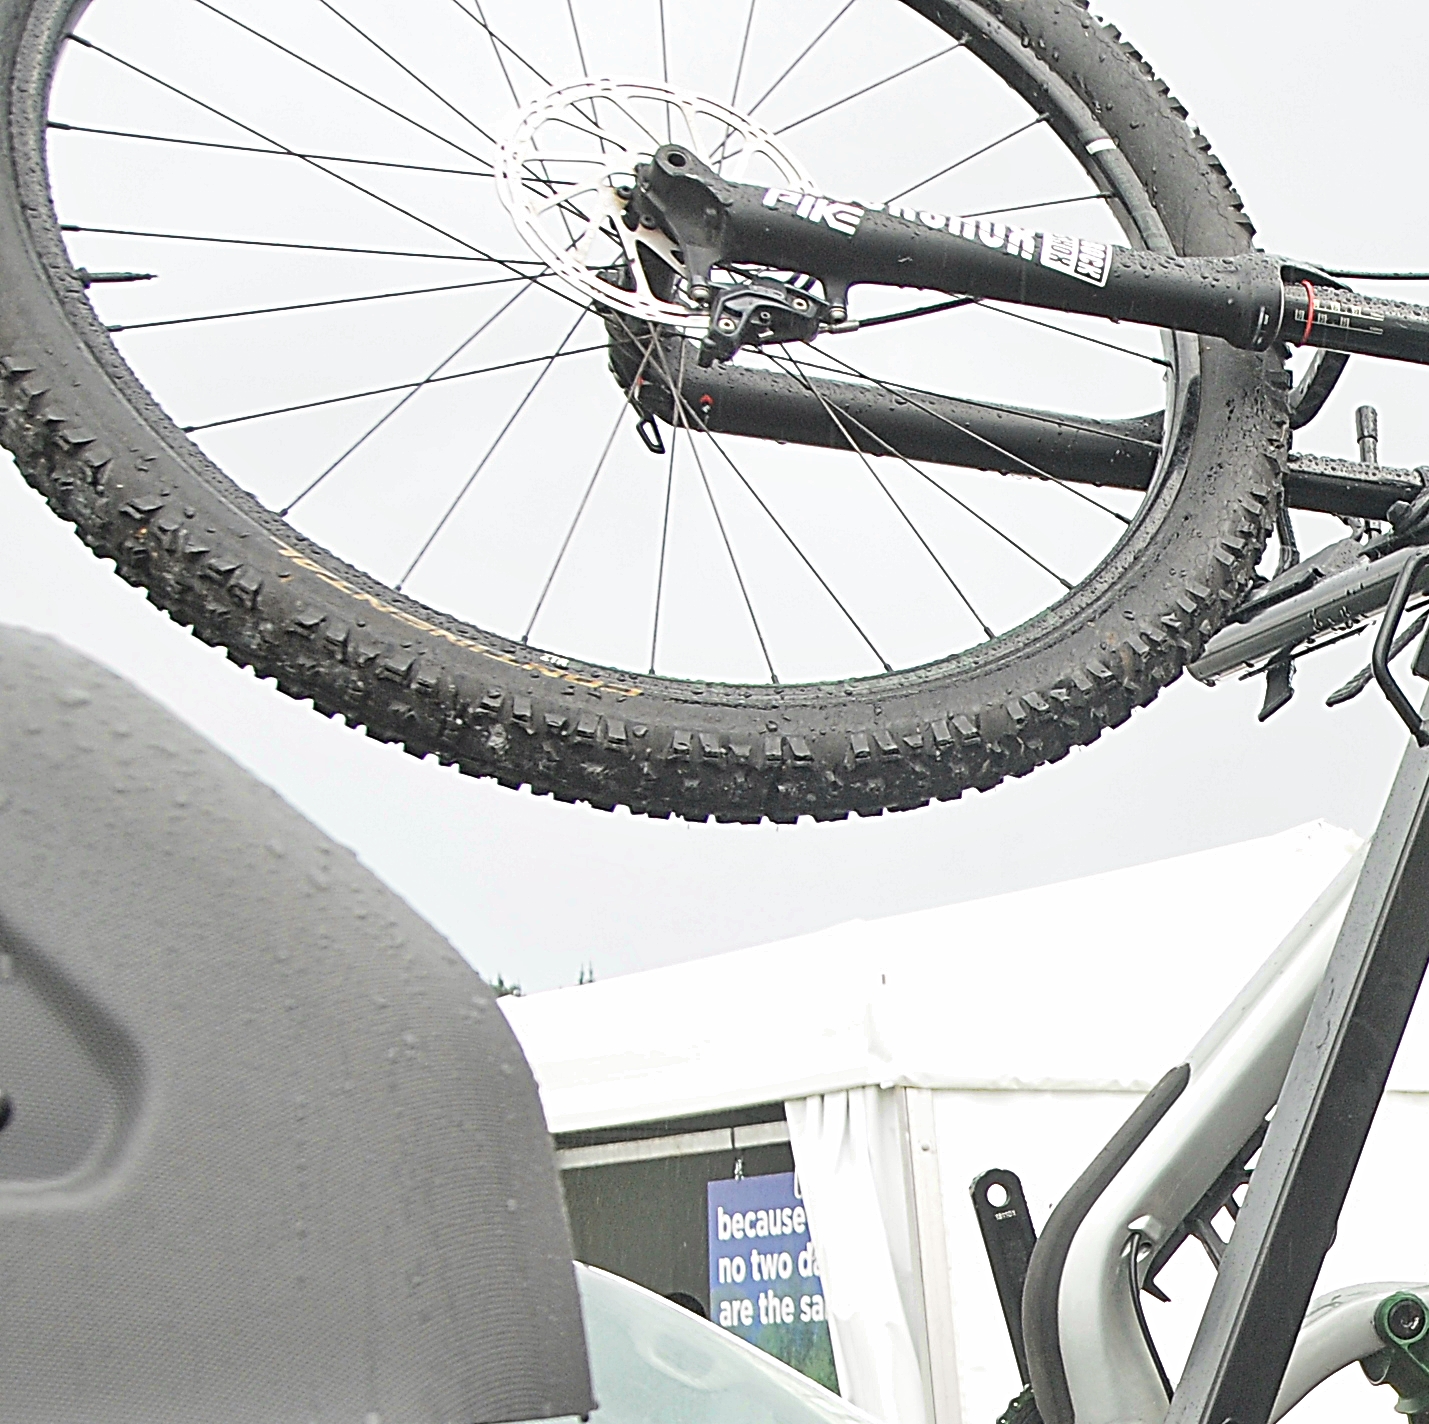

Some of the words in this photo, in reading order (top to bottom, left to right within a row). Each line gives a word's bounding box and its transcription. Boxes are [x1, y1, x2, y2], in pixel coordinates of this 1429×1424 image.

[717, 1206, 806, 1240] because
[718, 1256, 746, 1284] no
[751, 1249, 793, 1282] two
[719, 1299, 754, 1327] are
[759, 1290, 795, 1325] the
